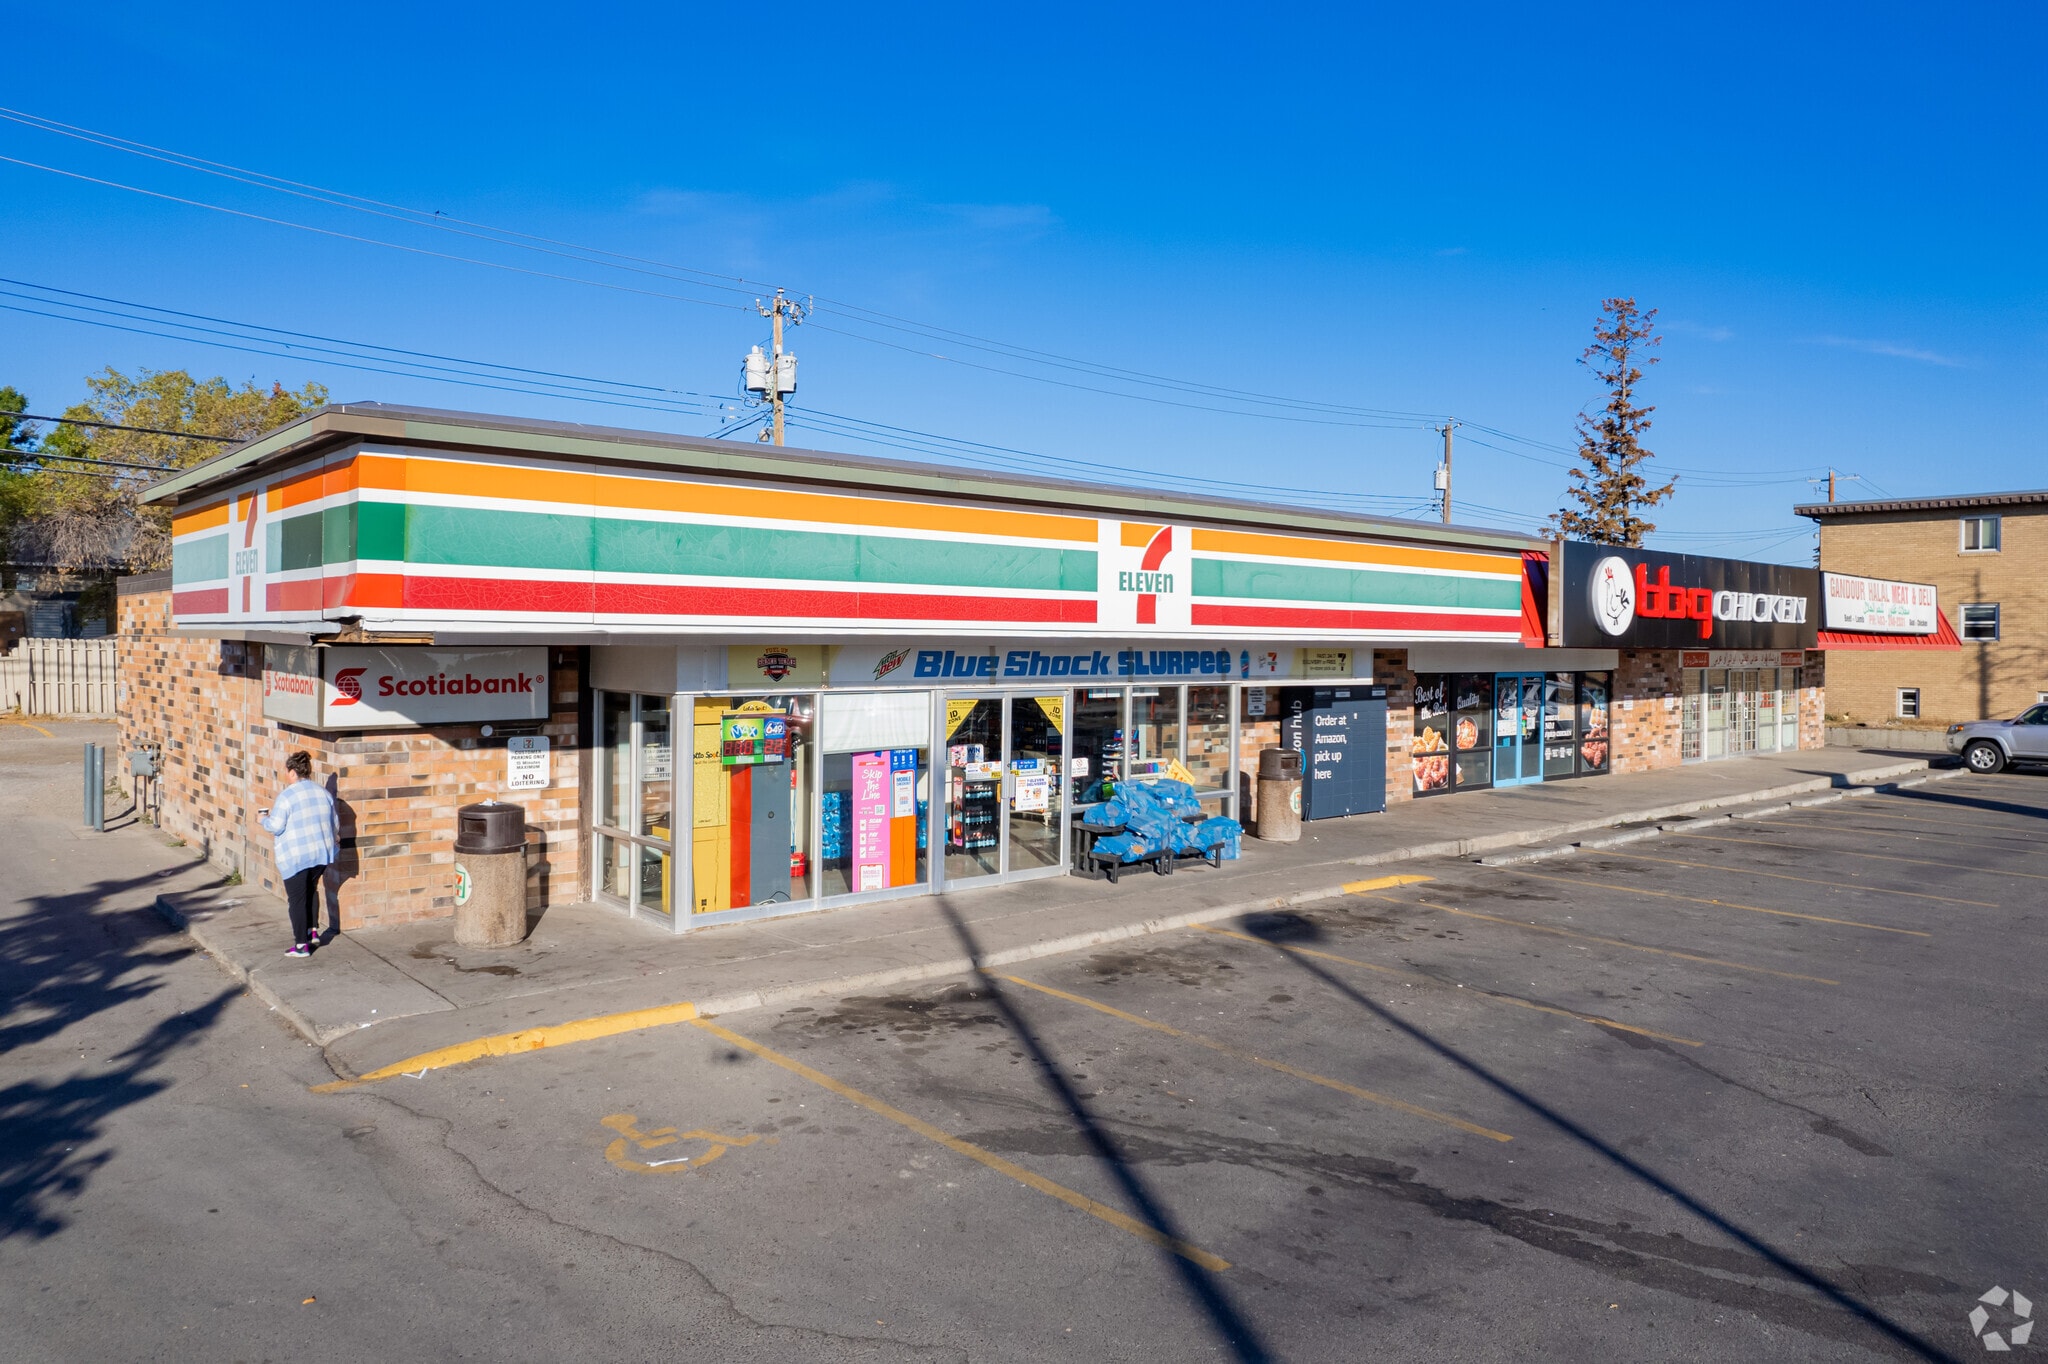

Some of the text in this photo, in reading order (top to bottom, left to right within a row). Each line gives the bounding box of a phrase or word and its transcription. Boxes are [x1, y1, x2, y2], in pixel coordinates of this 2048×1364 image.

[1120, 522, 1173, 624] 7
[1830, 577, 1932, 606] GANDOUR HALAL MEAT & DELI
[1713, 590, 1808, 624] CHICKEN
[914, 651, 1000, 677] Blue
[1003, 651, 1111, 676] Shock
[274, 671, 315, 697] Scotiabank
[1414, 681, 1445, 704] Best of
[1432, 701, 1448, 717] Best
[1457, 692, 1480, 710] Quality
[949, 710, 958, 718] ID
[1048, 711, 1061, 720] ZONE
[1052, 706, 1060, 714] ID
[947, 715, 962, 725] ZONE
[1315, 714, 1347, 726] Order at
[1314, 749, 1342, 765] pick up
[861, 768, 883, 782] Skip
[1314, 768, 1332, 780] here
[861, 789, 881, 801] Line
